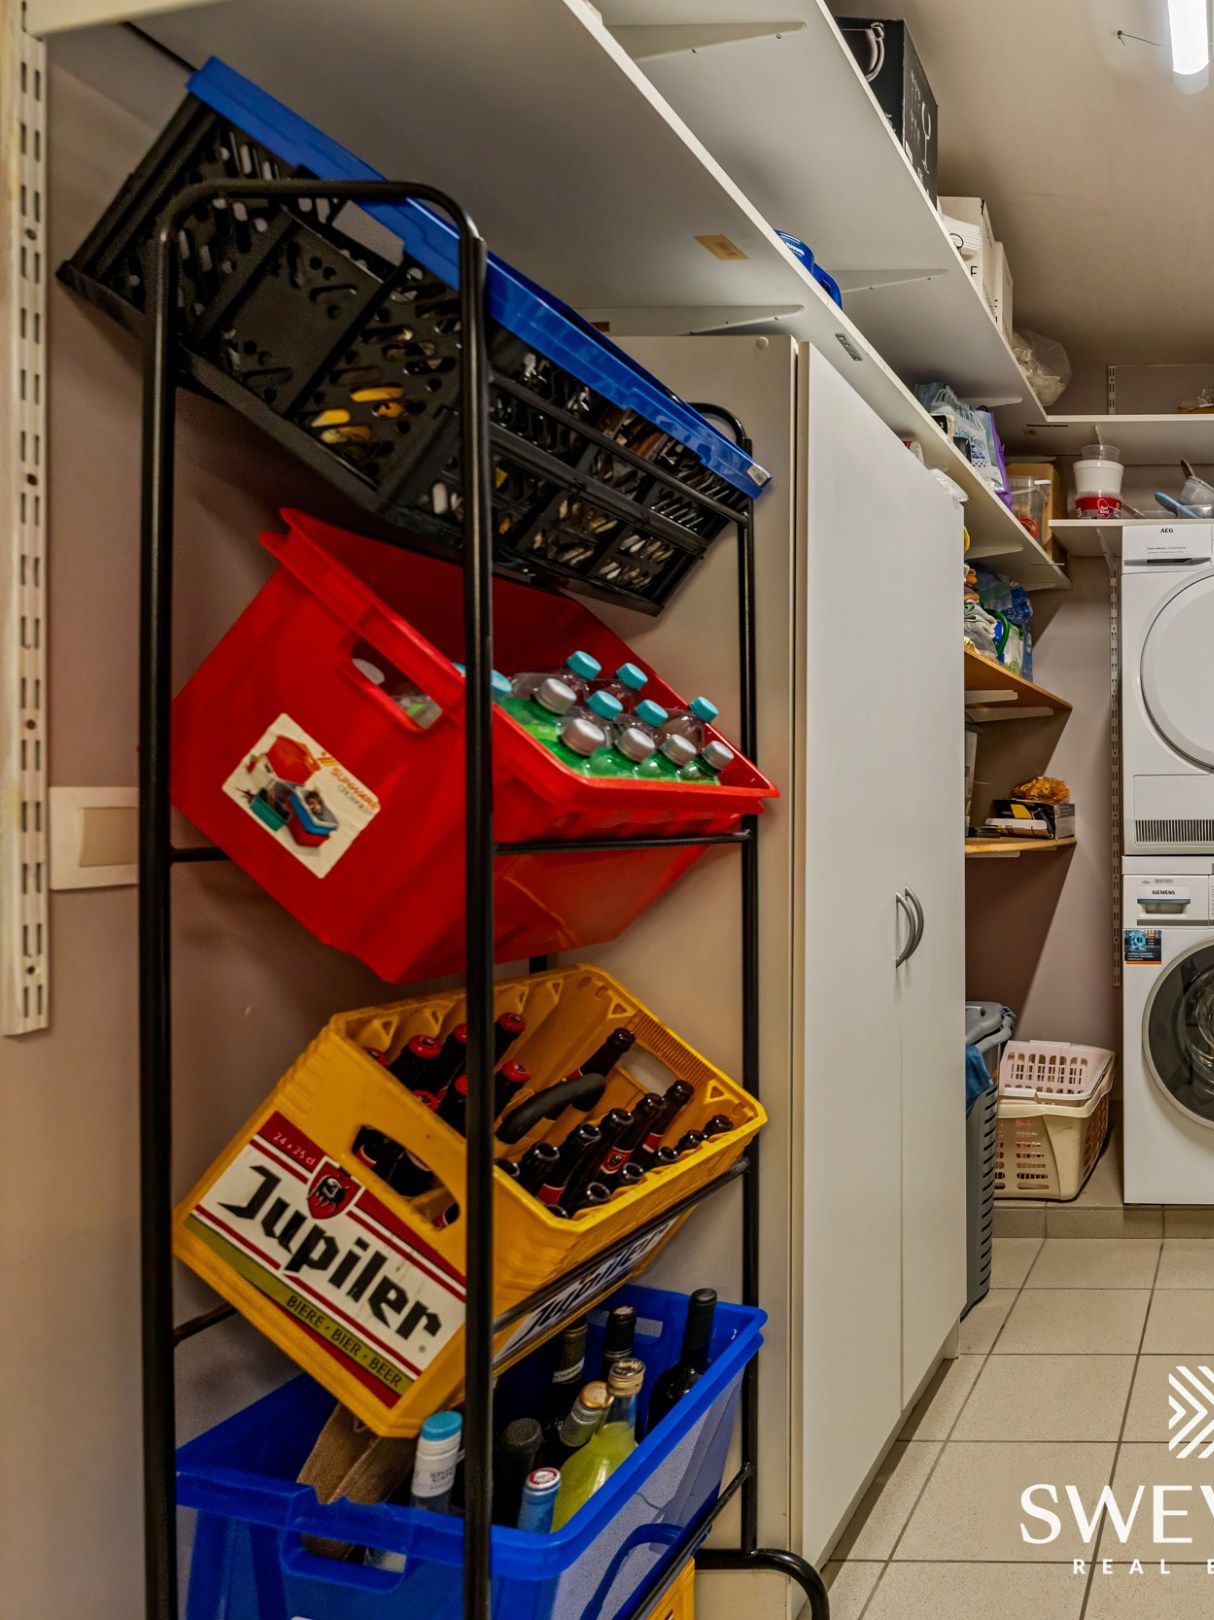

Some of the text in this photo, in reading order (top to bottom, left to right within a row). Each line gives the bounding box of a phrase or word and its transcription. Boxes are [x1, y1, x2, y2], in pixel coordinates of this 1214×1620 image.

[217, 1164, 443, 1341] Jupiler
[285, 1294, 402, 1388] BIERE BIER BEER
